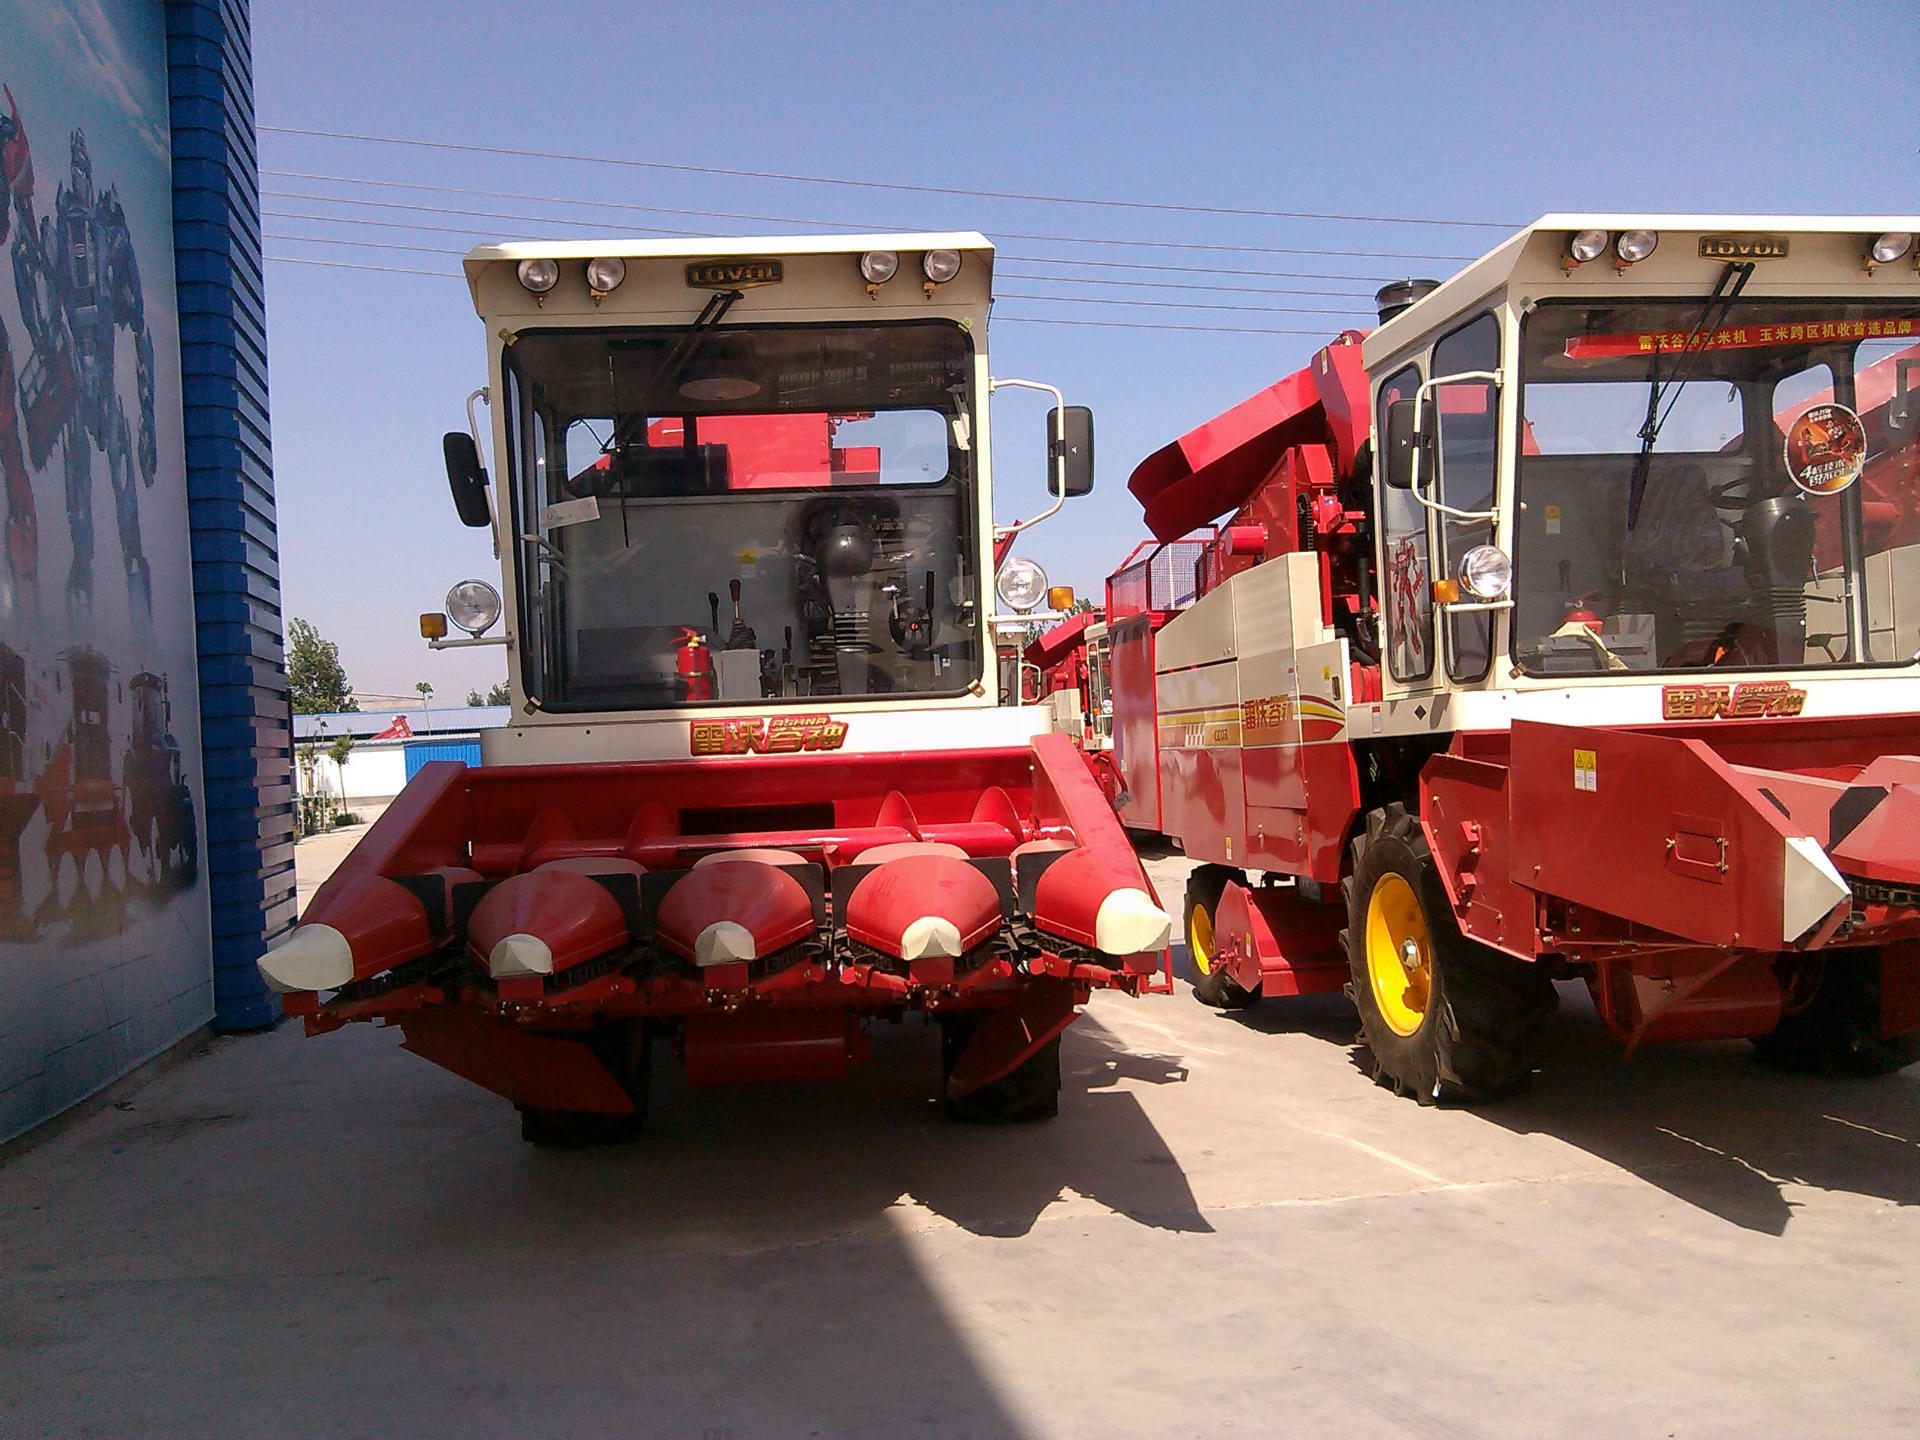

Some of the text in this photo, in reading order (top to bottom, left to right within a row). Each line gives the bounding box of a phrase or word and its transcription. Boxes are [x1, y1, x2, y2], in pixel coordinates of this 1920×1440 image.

[1705, 239, 1784, 255] LOVOL
[693, 265, 779, 282] LOVOL
[1759, 320, 1913, 342] 玉米跨区机收首选品牌
[1666, 687, 1806, 718] 雷沃谷神
[693, 721, 843, 753] 雷沃谷神
